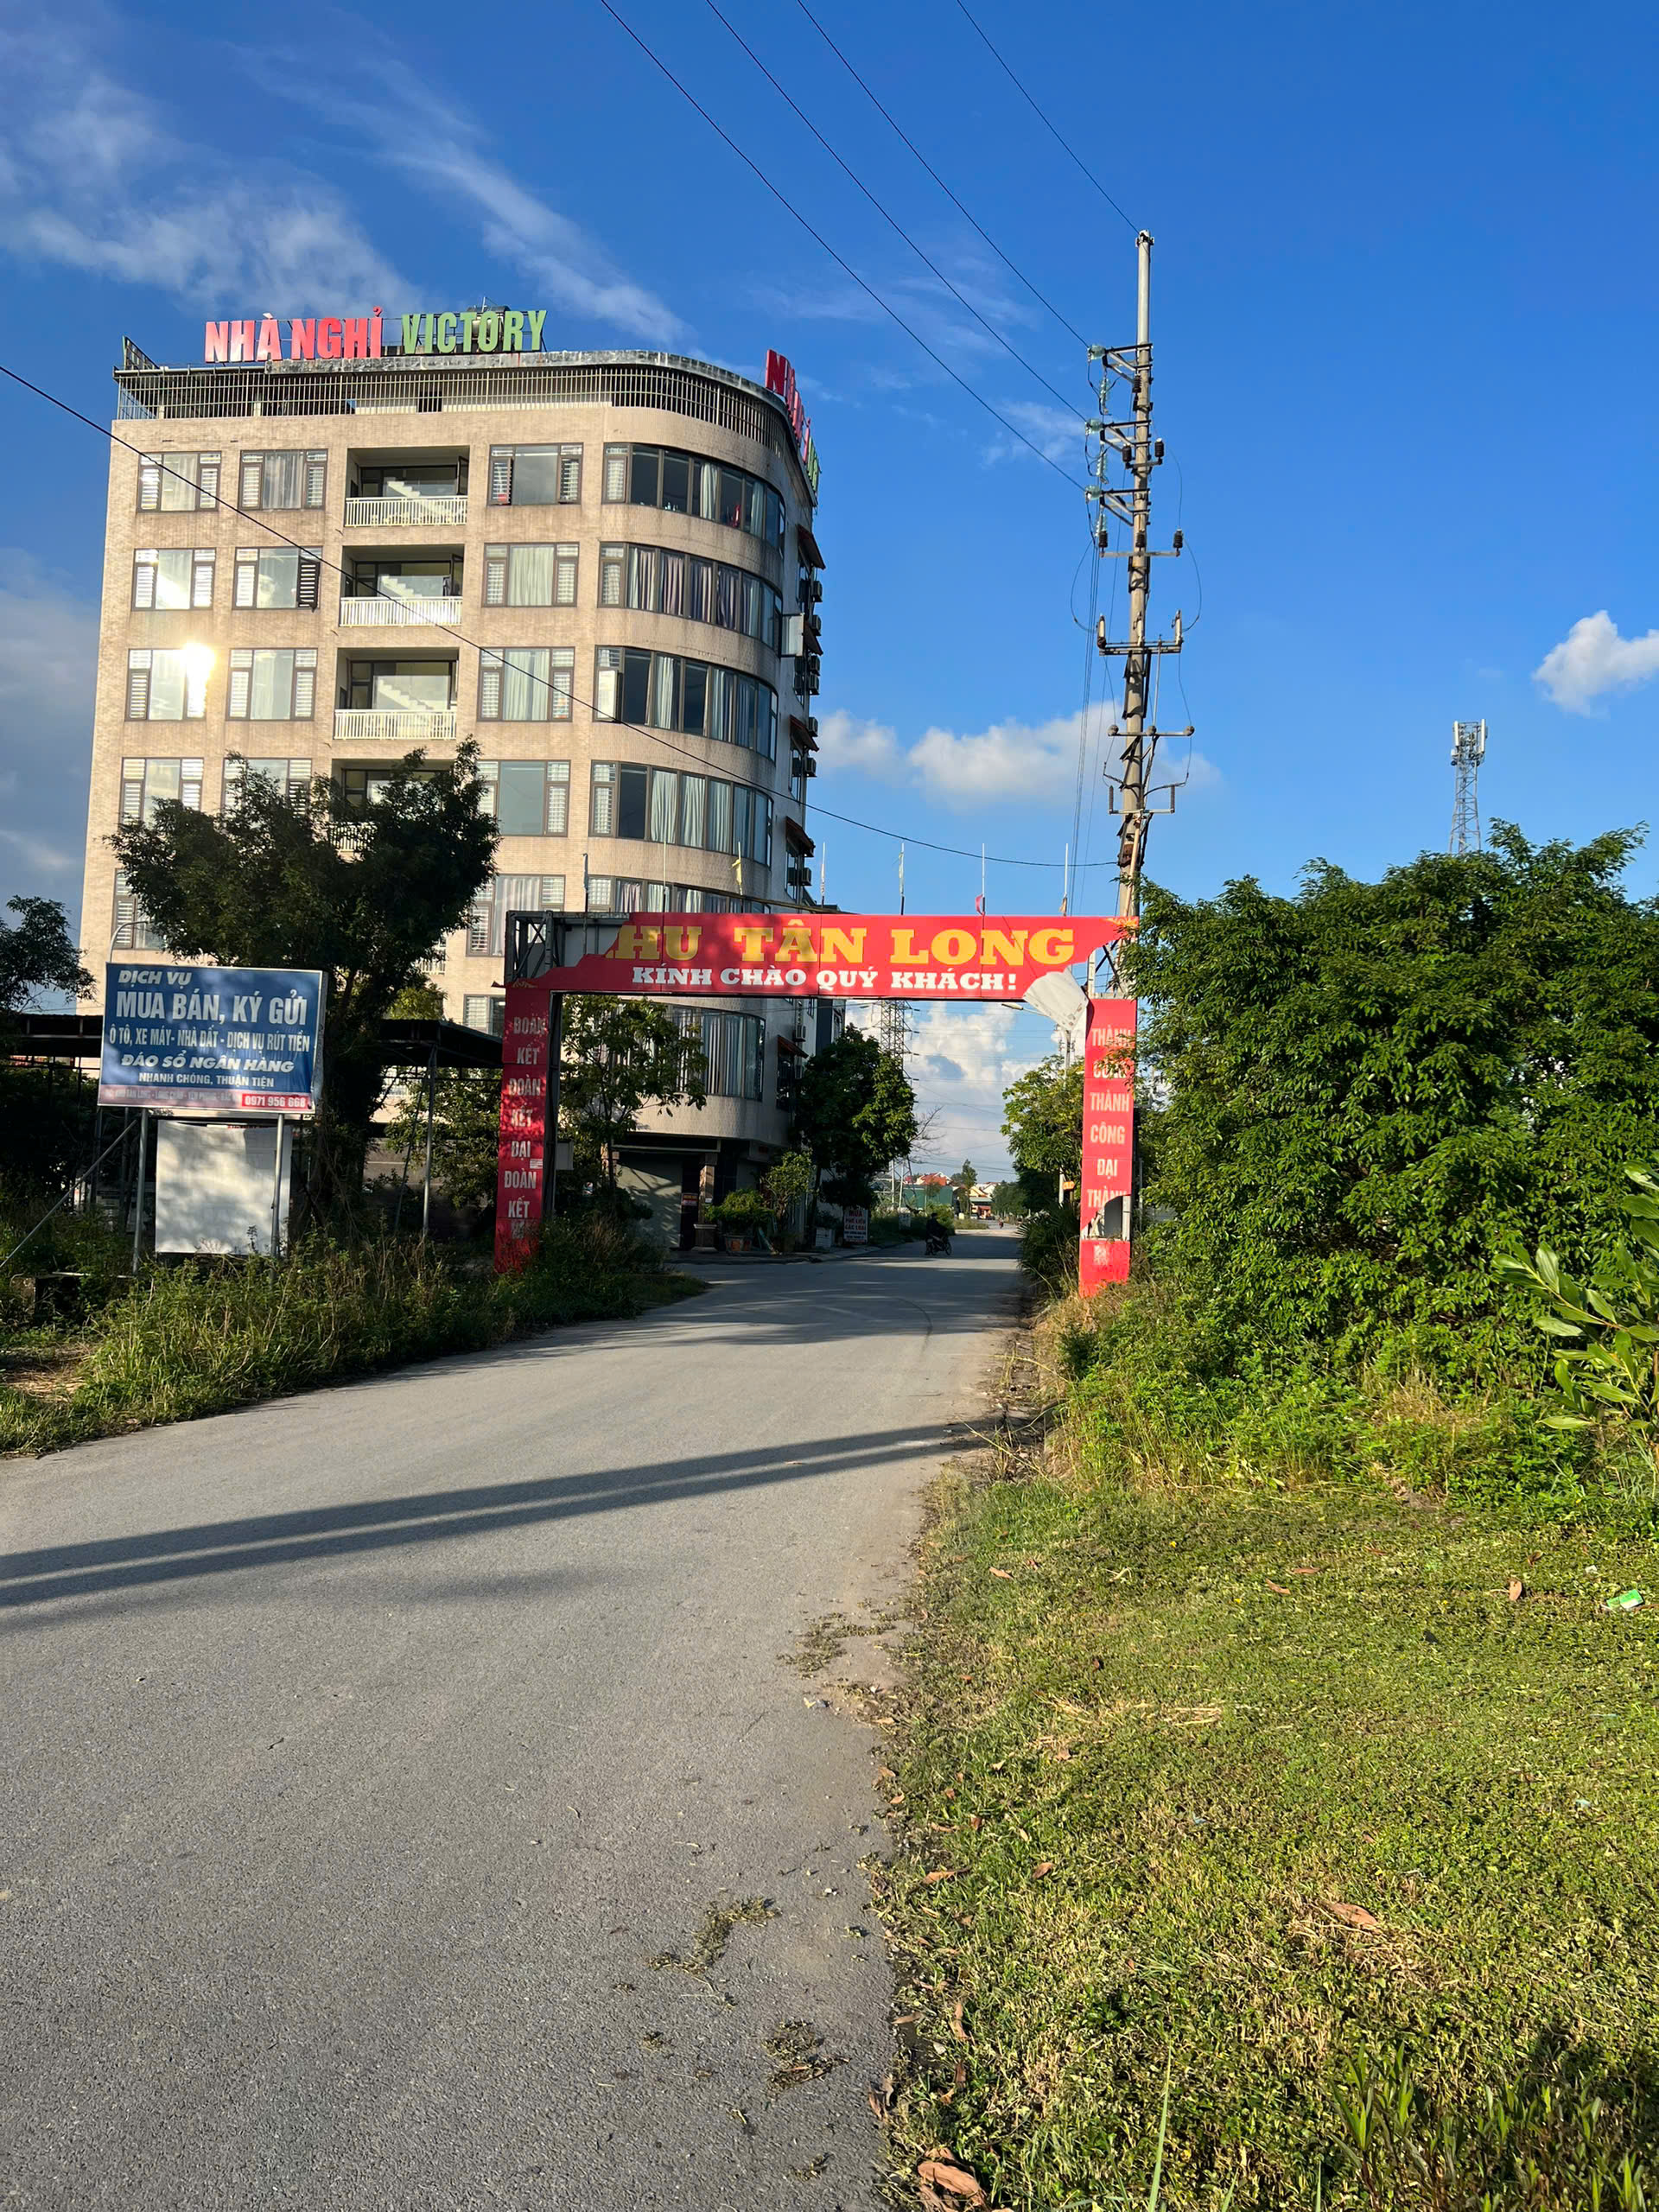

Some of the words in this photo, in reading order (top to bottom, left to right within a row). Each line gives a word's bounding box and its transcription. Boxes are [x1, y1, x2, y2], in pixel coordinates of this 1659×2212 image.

[206, 313, 282, 362] NHÀ
[290, 306, 383, 359] NGHỈ
[402, 309, 547, 354] VICTORY
[606, 925, 702, 961] HU
[734, 918, 867, 963] TÂN
[890, 928, 1074, 966] LONG
[118, 969, 163, 988] DỊCH
[167, 971, 193, 989] VỤ
[632, 963, 712, 986] KÍNH
[720, 964, 807, 987] CHÀO
[816, 966, 877, 990] QUÝ
[891, 968, 1016, 991] KHÁCH!
[117, 991, 165, 1019] MUA
[173, 988, 225, 1025] BÁN,
[232, 990, 264, 1023] KÝ
[269, 988, 308, 1026] GỬI
[109, 1023, 117, 1045] Ô
[118, 1023, 133, 1047] TÔ,
[135, 1027, 148, 1045] XE
[177, 1027, 197, 1047] NHÀ
[226, 1031, 251, 1052] DỊCH
[252, 1033, 264, 1054] VỤ
[267, 1030, 286, 1052] RÚT
[1091, 1024, 1131, 1047] THÀNH
[121, 1051, 160, 1068] ĐÁO
[162, 1049, 188, 1069] SỔ
[189, 1055, 242, 1071] NGÂN
[243, 1057, 295, 1073] HÀNG
[138, 1072, 174, 1083] NHANH
[216, 1073, 250, 1089] THUẬN
[251, 1076, 275, 1090] TIỆN
[508, 1074, 541, 1096] ĐOÀN
[245, 1095, 265, 1107] 0971
[267, 1096, 286, 1107] 956
[288, 1097, 306, 1108] 668
[1090, 1089, 1129, 1112] THÀNH
[1090, 1121, 1125, 1145] CÔNG
[512, 1141, 531, 1160] ĐẠI
[505, 1168, 537, 1189] ĐOÀN
[1096, 1159, 1118, 1179] ĐẠI
[508, 1196, 530, 1218] KẾT
